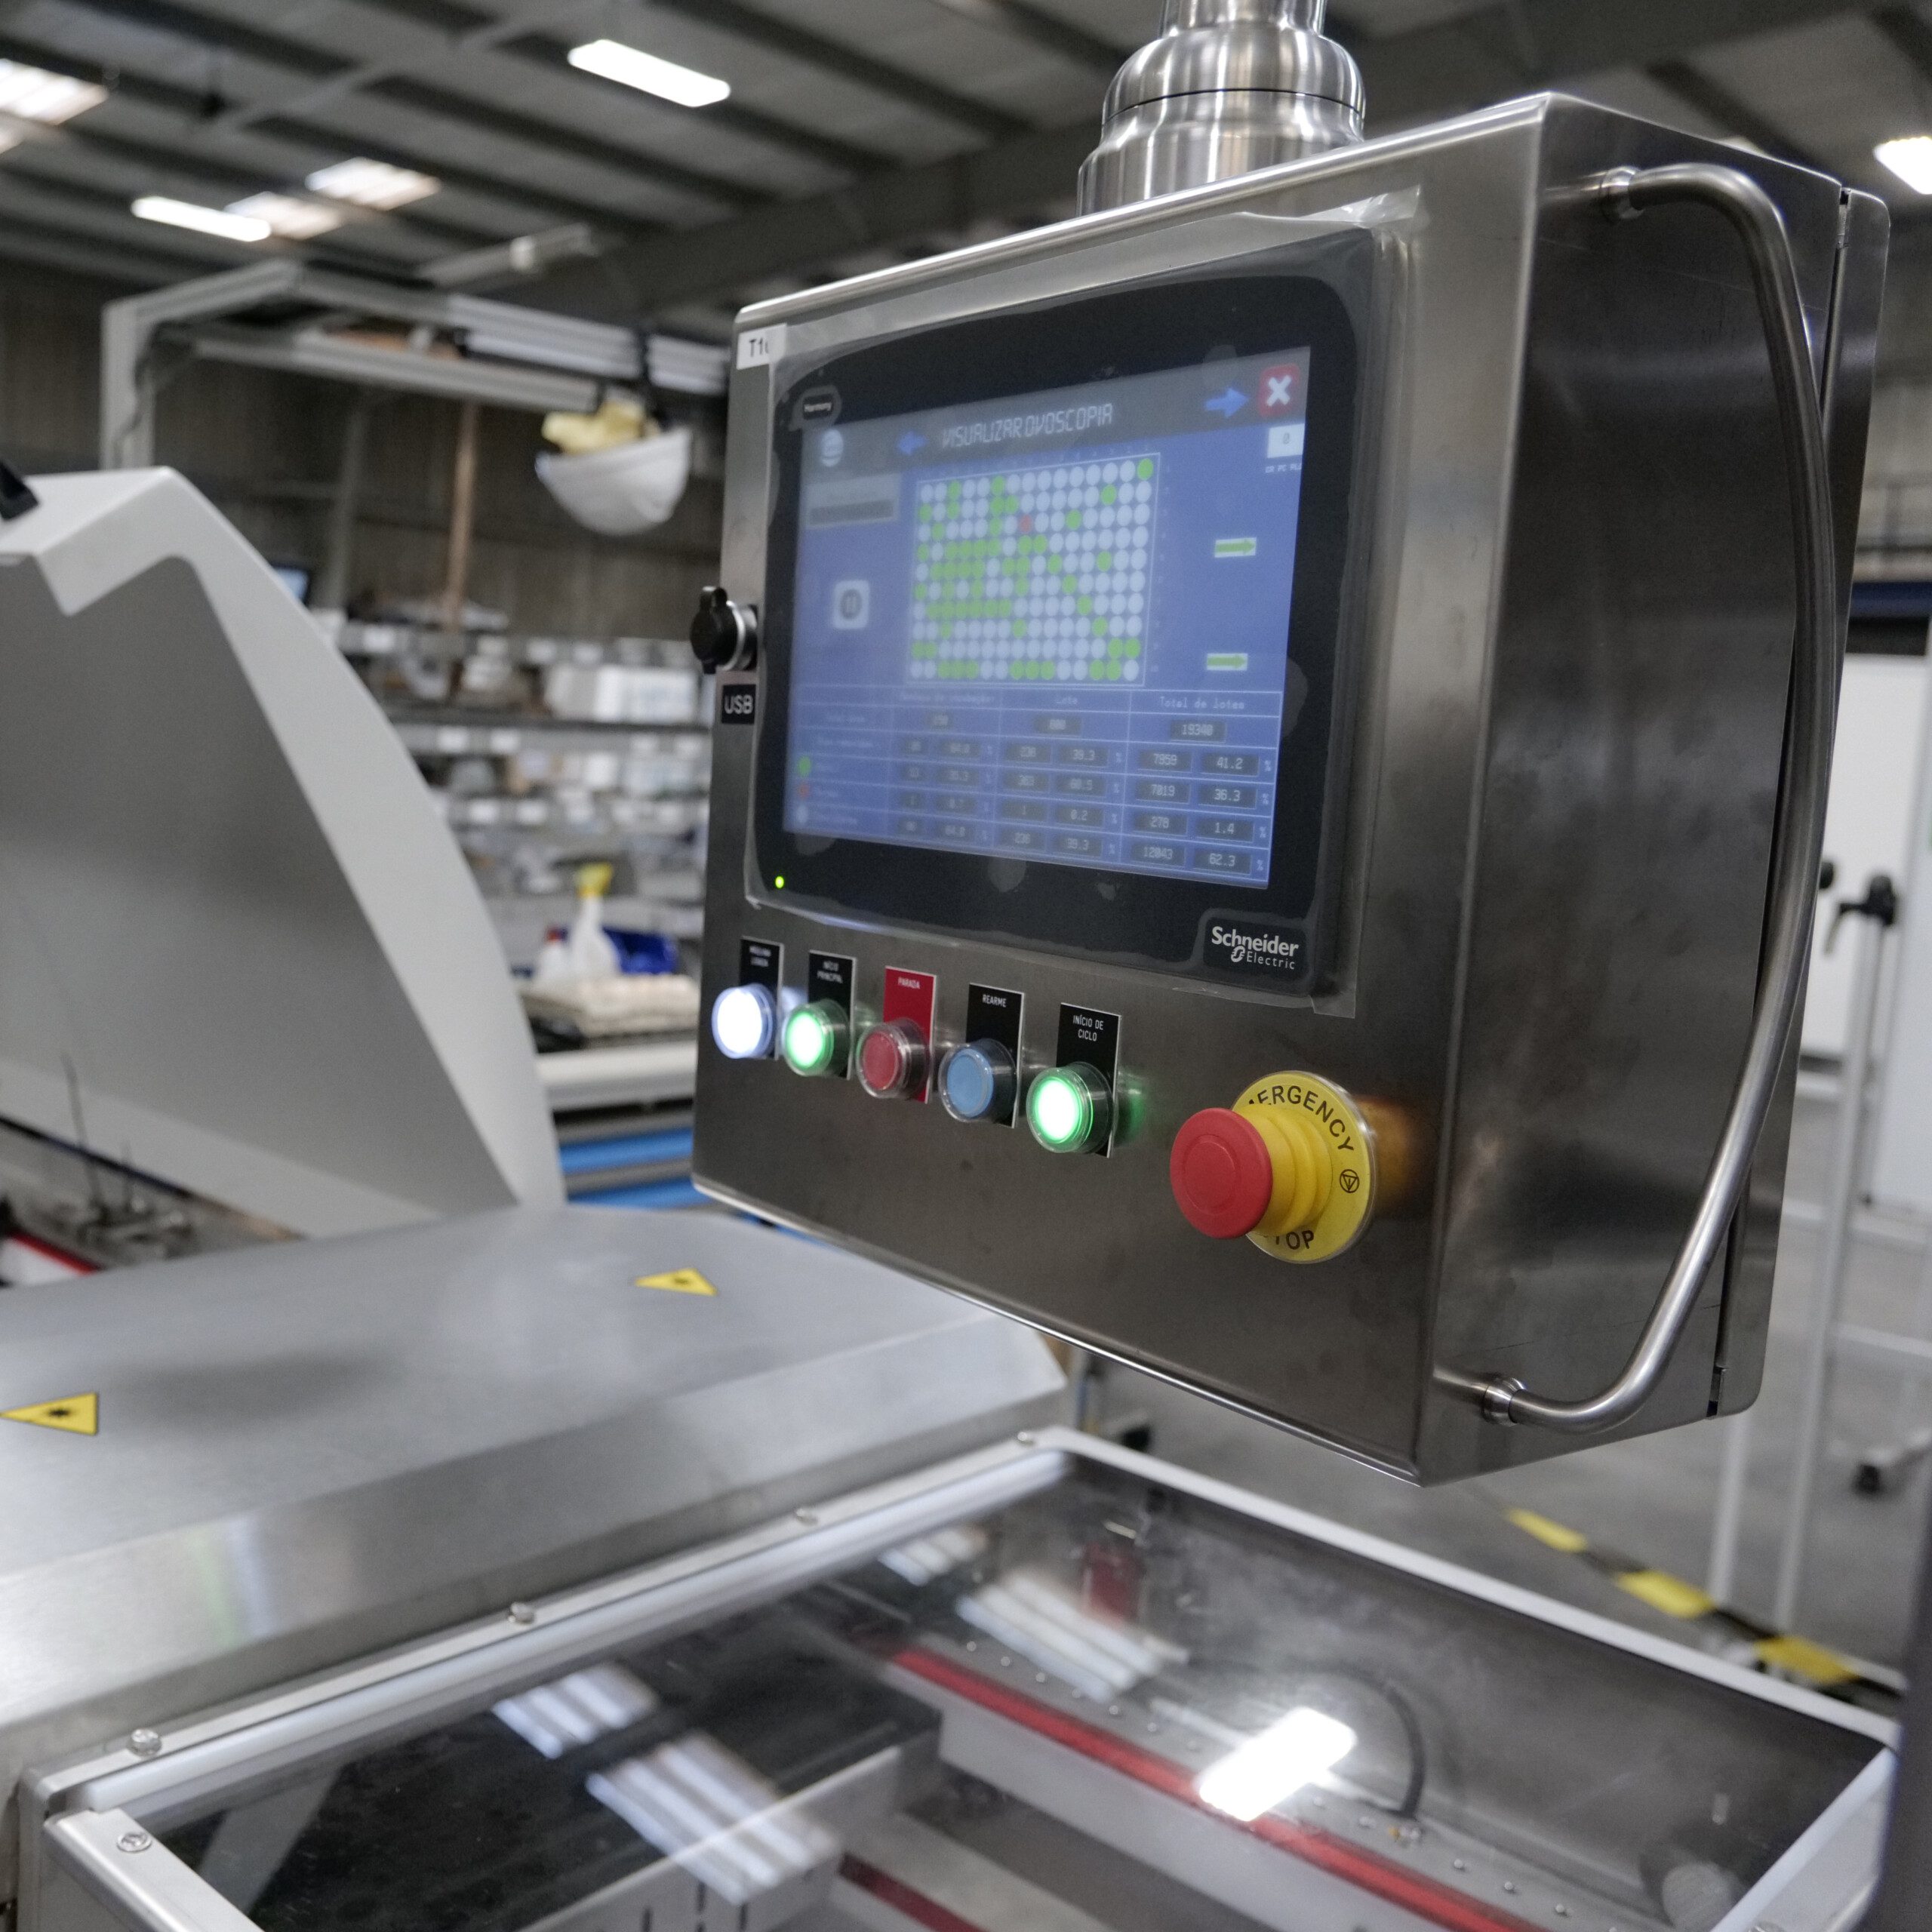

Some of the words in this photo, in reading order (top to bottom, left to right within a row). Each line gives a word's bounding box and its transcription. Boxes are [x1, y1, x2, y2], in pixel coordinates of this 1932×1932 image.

[941, 417, 1022, 448] VISUALIZAR
[1025, 403, 1113, 437] OVOSCOPIA
[724, 694, 753, 714] USB
[1160, 696, 1187, 708] Total
[1194, 697, 1207, 709] de
[1213, 697, 1244, 709] lotes
[1216, 757, 1243, 769] 41.2
[1151, 783, 1175, 797] 7019
[1214, 789, 1241, 802] 36.3
[1070, 809, 1088, 821] 0.2
[1150, 816, 1170, 829] 278
[1214, 822, 1235, 834] 1.4
[1143, 846, 1173, 860] 12043
[1209, 853, 1235, 866] 62.3
[1211, 925, 1300, 957] Schneider
[1246, 951, 1295, 970] Electric
[897, 977, 920, 989] PARADA
[983, 994, 1007, 1008] REARME
[1072, 1014, 1093, 1028] INÍCIO
[1095, 1020, 1104, 1030] DE
[1078, 1029, 1097, 1041] CICLO
[1248, 1084, 1355, 1152] ERGENCY
